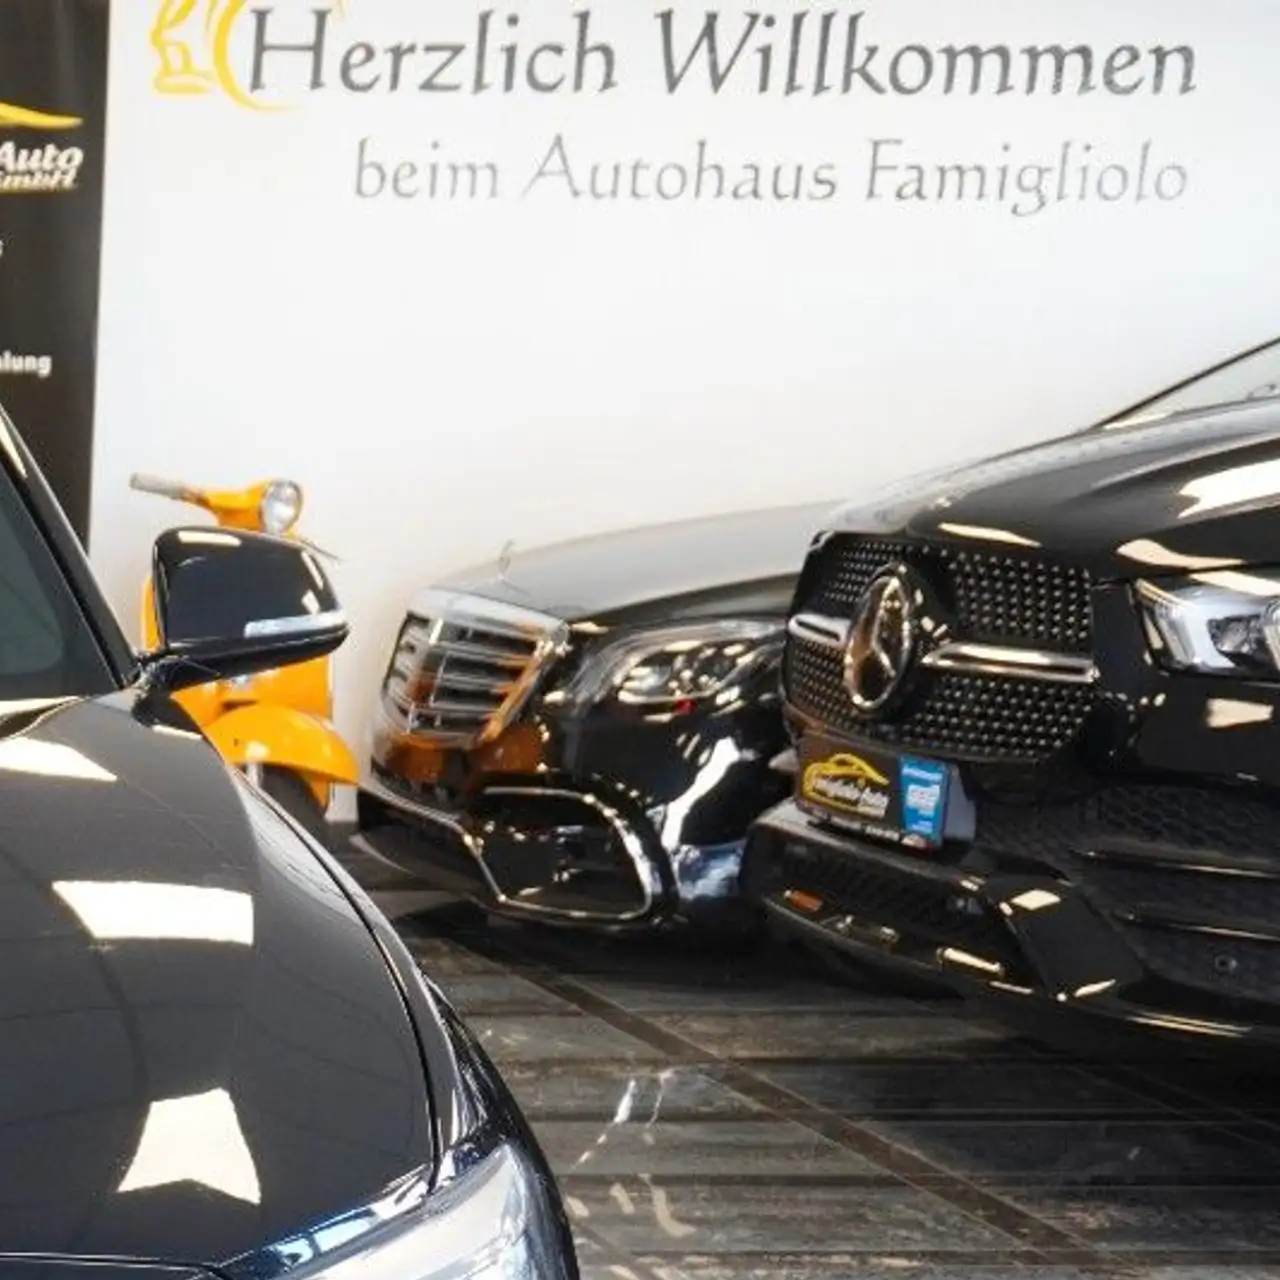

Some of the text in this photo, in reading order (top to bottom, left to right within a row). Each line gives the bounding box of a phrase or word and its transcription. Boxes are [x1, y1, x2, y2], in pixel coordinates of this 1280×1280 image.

[249, 7, 1197, 97] Herzlich Willkommen
[354, 132, 1189, 218] beim Autohaus Famigliolo
